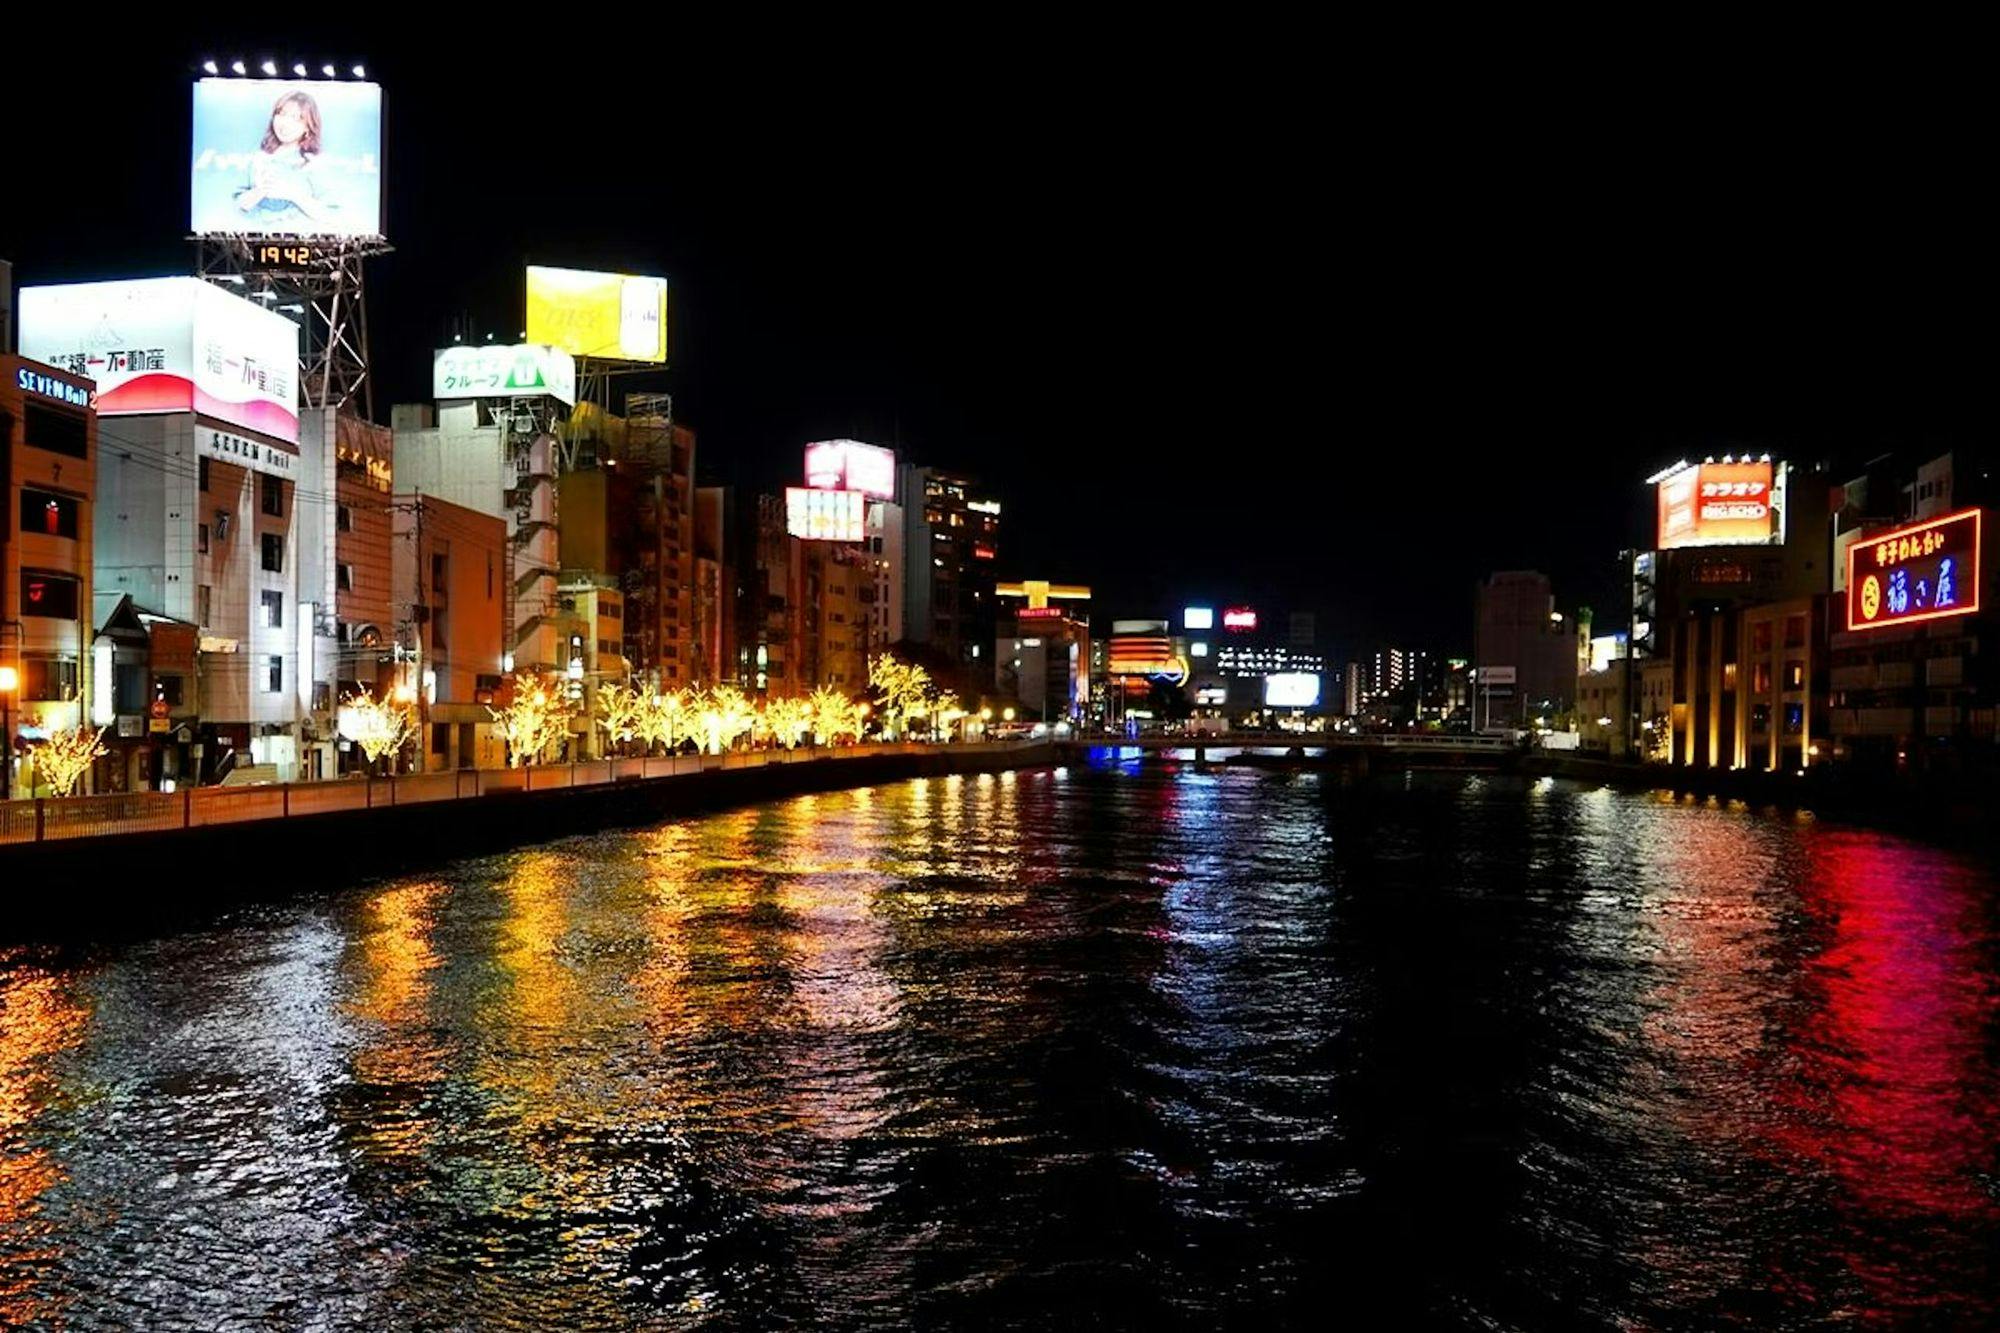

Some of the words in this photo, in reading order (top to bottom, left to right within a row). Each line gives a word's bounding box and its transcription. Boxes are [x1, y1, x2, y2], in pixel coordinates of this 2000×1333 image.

[18, 368, 64, 399] SEVEN
[212, 432, 259, 460] SEVEN
[1702, 482, 1766, 497] カラオケ
[1887, 558, 1954, 613] 福さ屋
